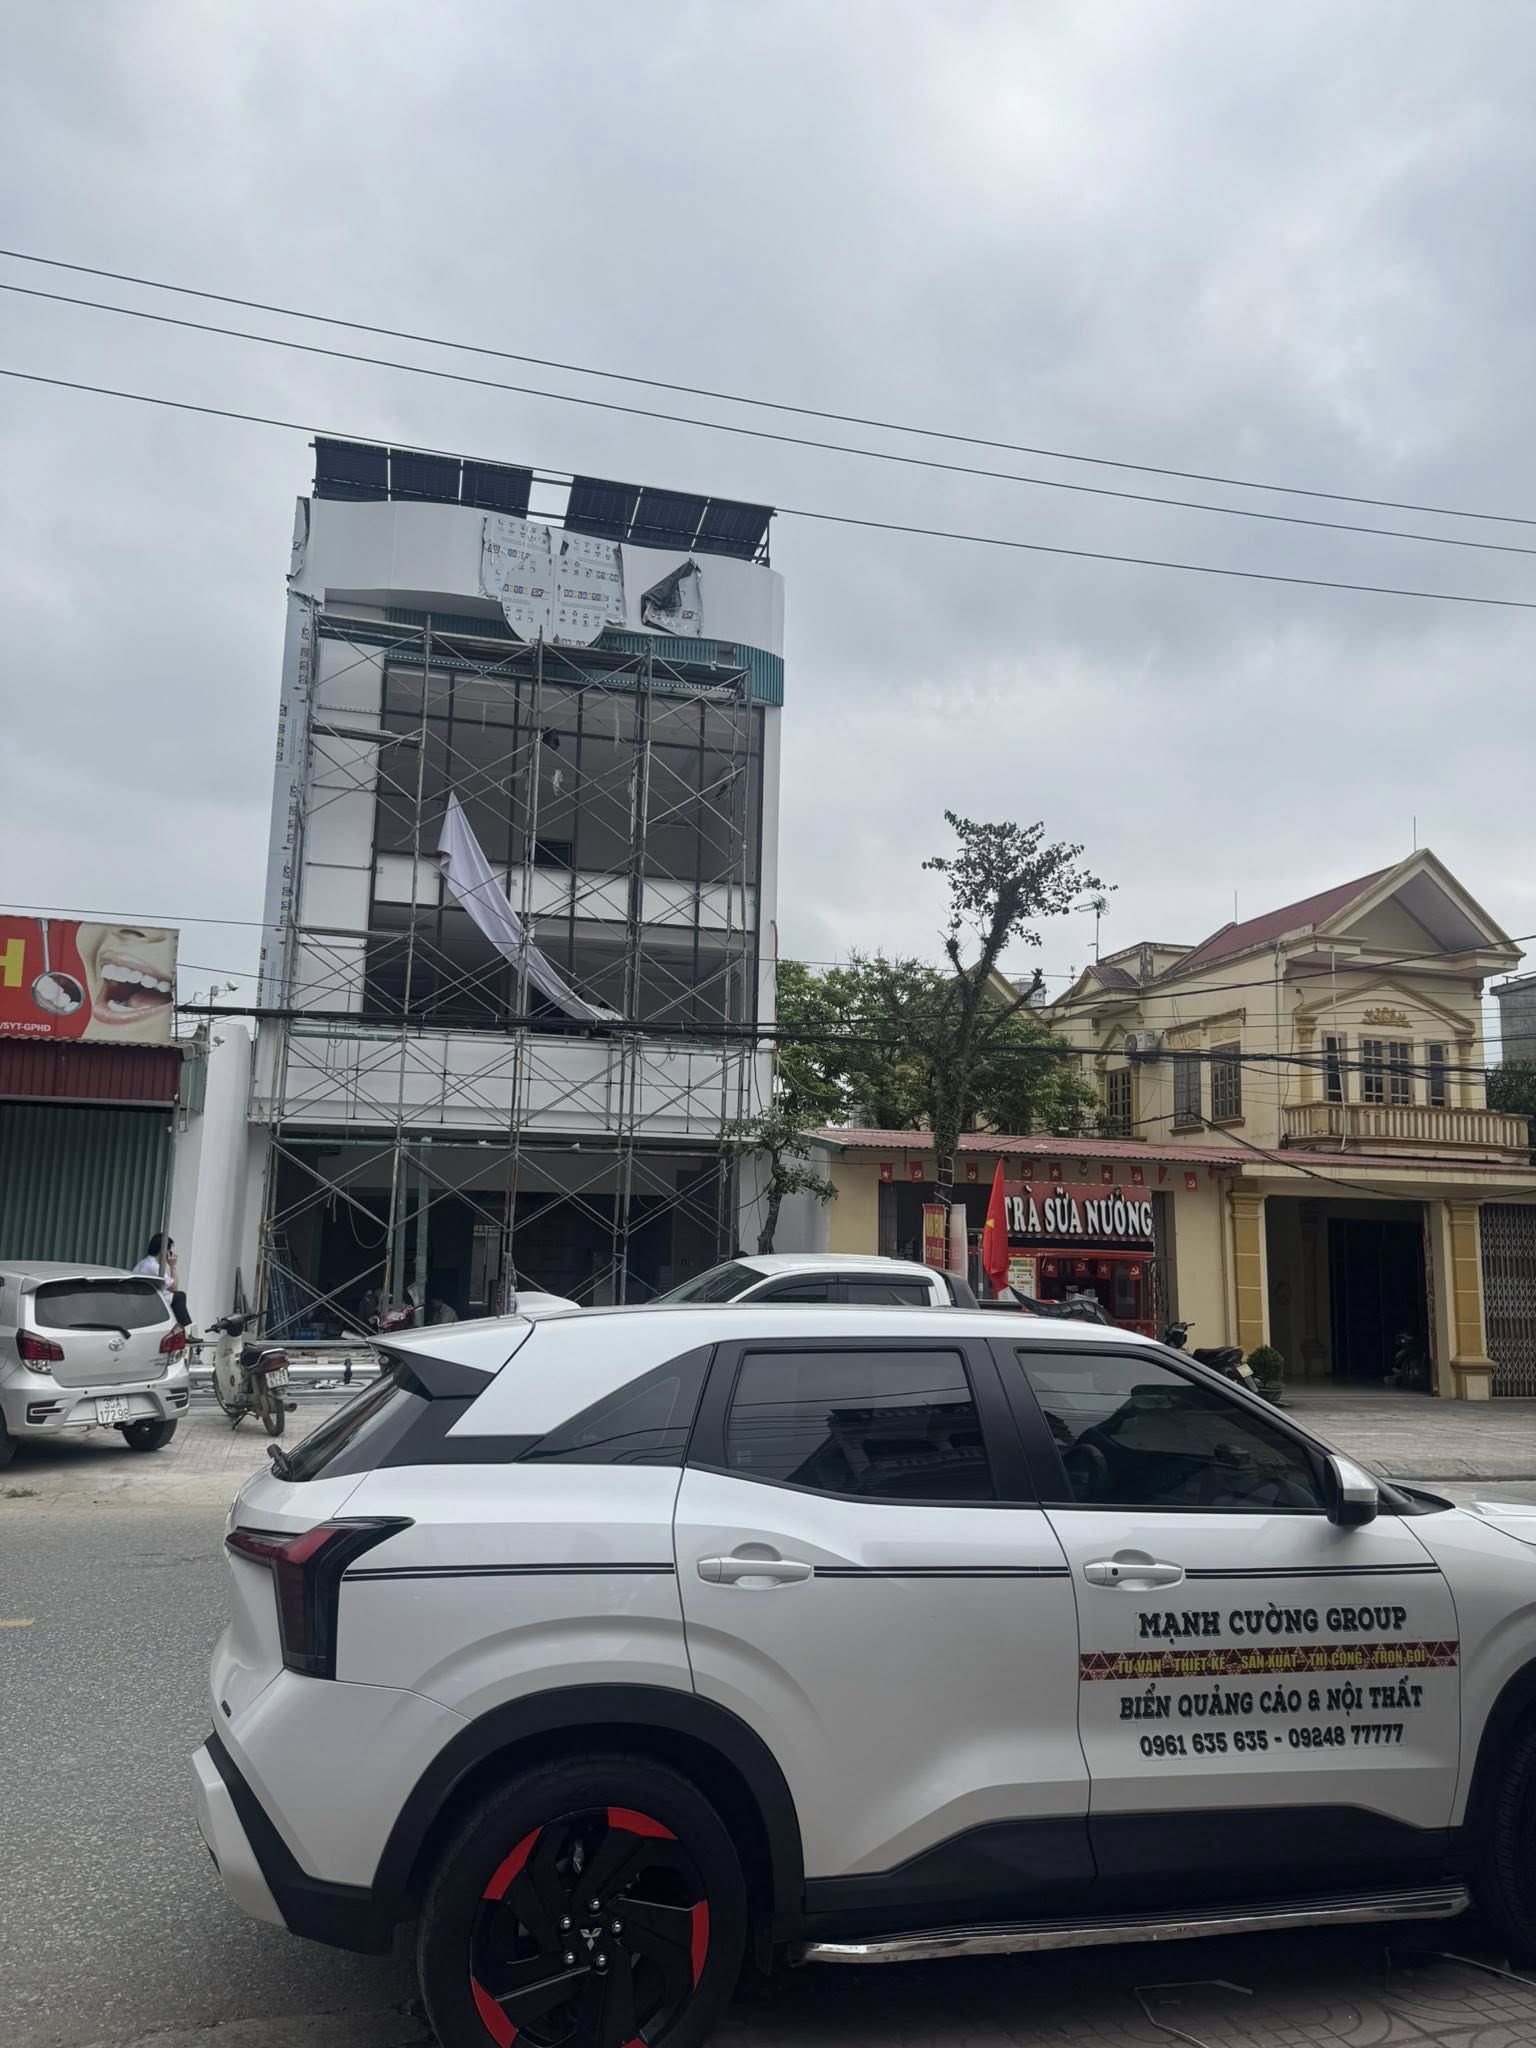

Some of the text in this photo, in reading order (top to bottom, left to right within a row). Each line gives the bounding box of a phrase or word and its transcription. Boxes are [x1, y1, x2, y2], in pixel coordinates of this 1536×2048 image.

[1004, 1184, 1041, 1233] TRÀ
[1045, 1185, 1083, 1234] SỮA
[1139, 1602, 1408, 1645] MẠNH CƯỜNG GROUP
[1120, 1675, 1423, 1720] BIỂN QUẢNG CÁO & NỘI THẤT
[1140, 1734, 1188, 1757] 0961
[1192, 1732, 1228, 1754] 635
[1233, 1730, 1268, 1752] 635
[1288, 1725, 1346, 1748] 09248
[1350, 1723, 1404, 1745] 77777
